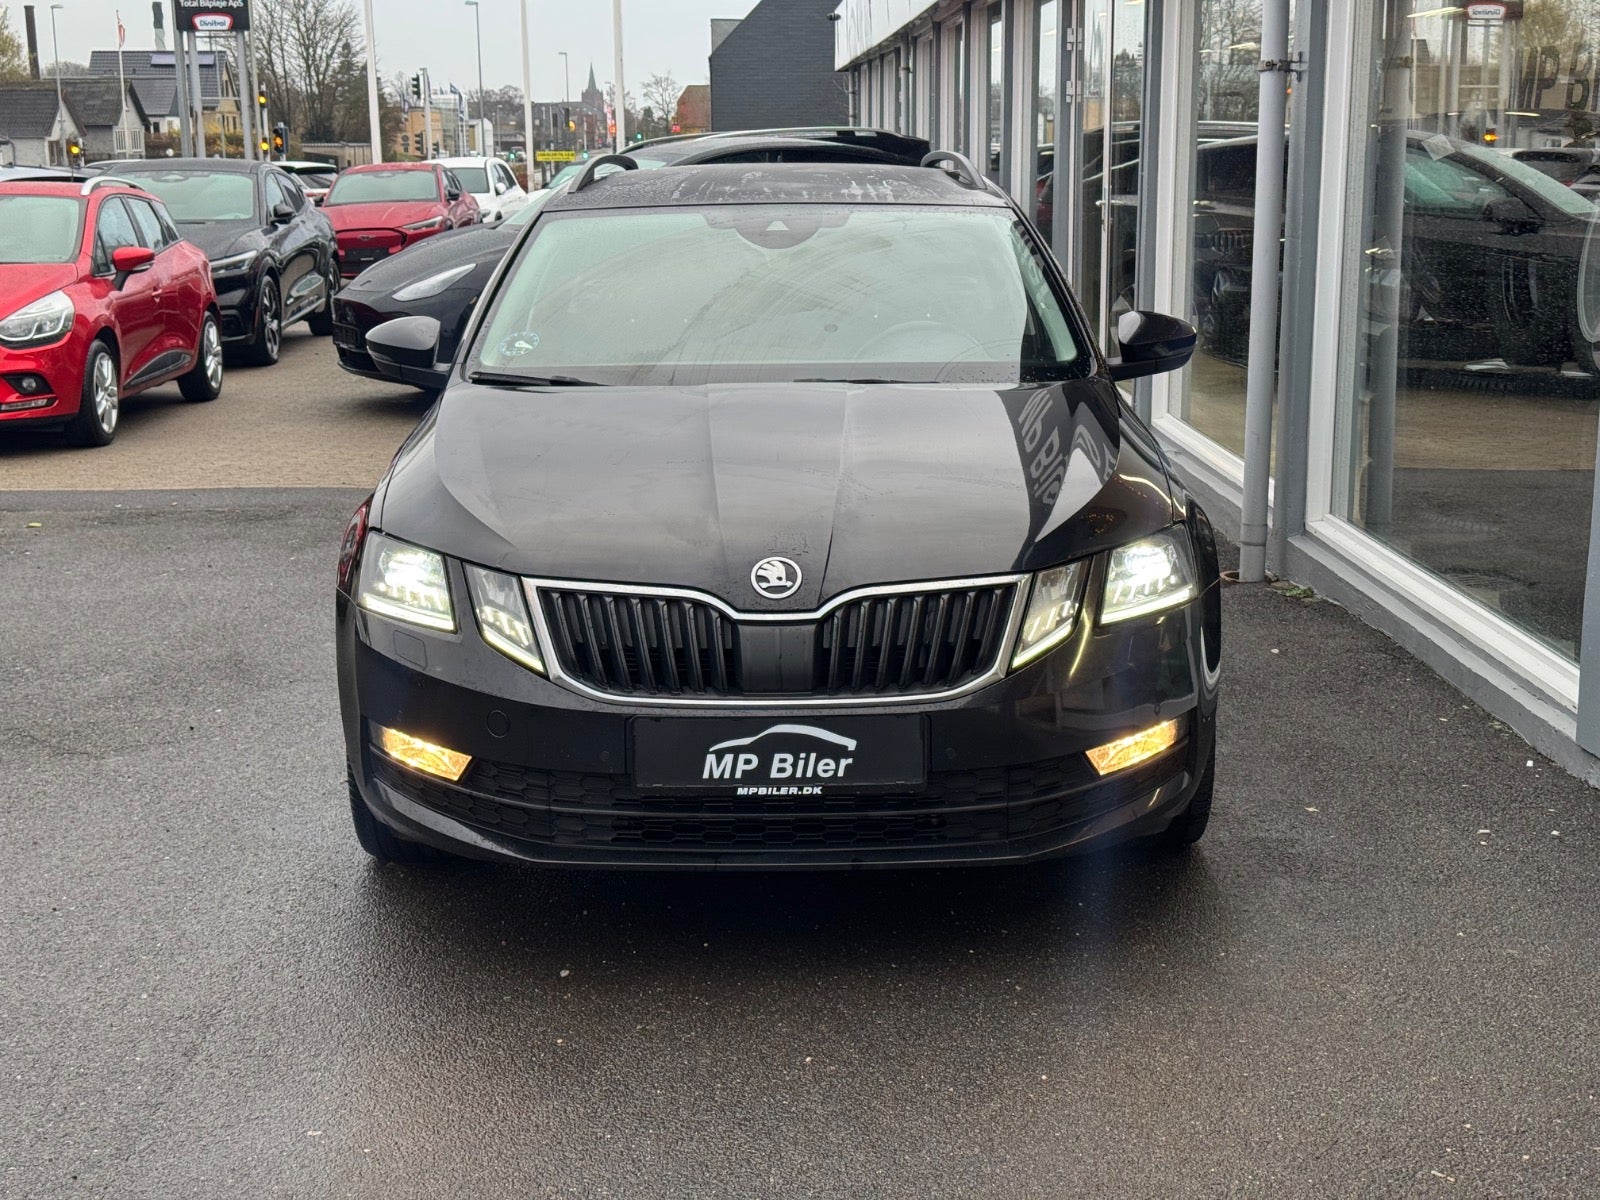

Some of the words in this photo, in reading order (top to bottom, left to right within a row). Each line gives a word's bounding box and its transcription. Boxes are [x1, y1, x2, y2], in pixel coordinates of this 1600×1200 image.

[228, 0, 244, 8] ApS
[702, 753, 759, 779] MP
[770, 752, 853, 779] Biler
[736, 786, 823, 795] MPBILER.DK
